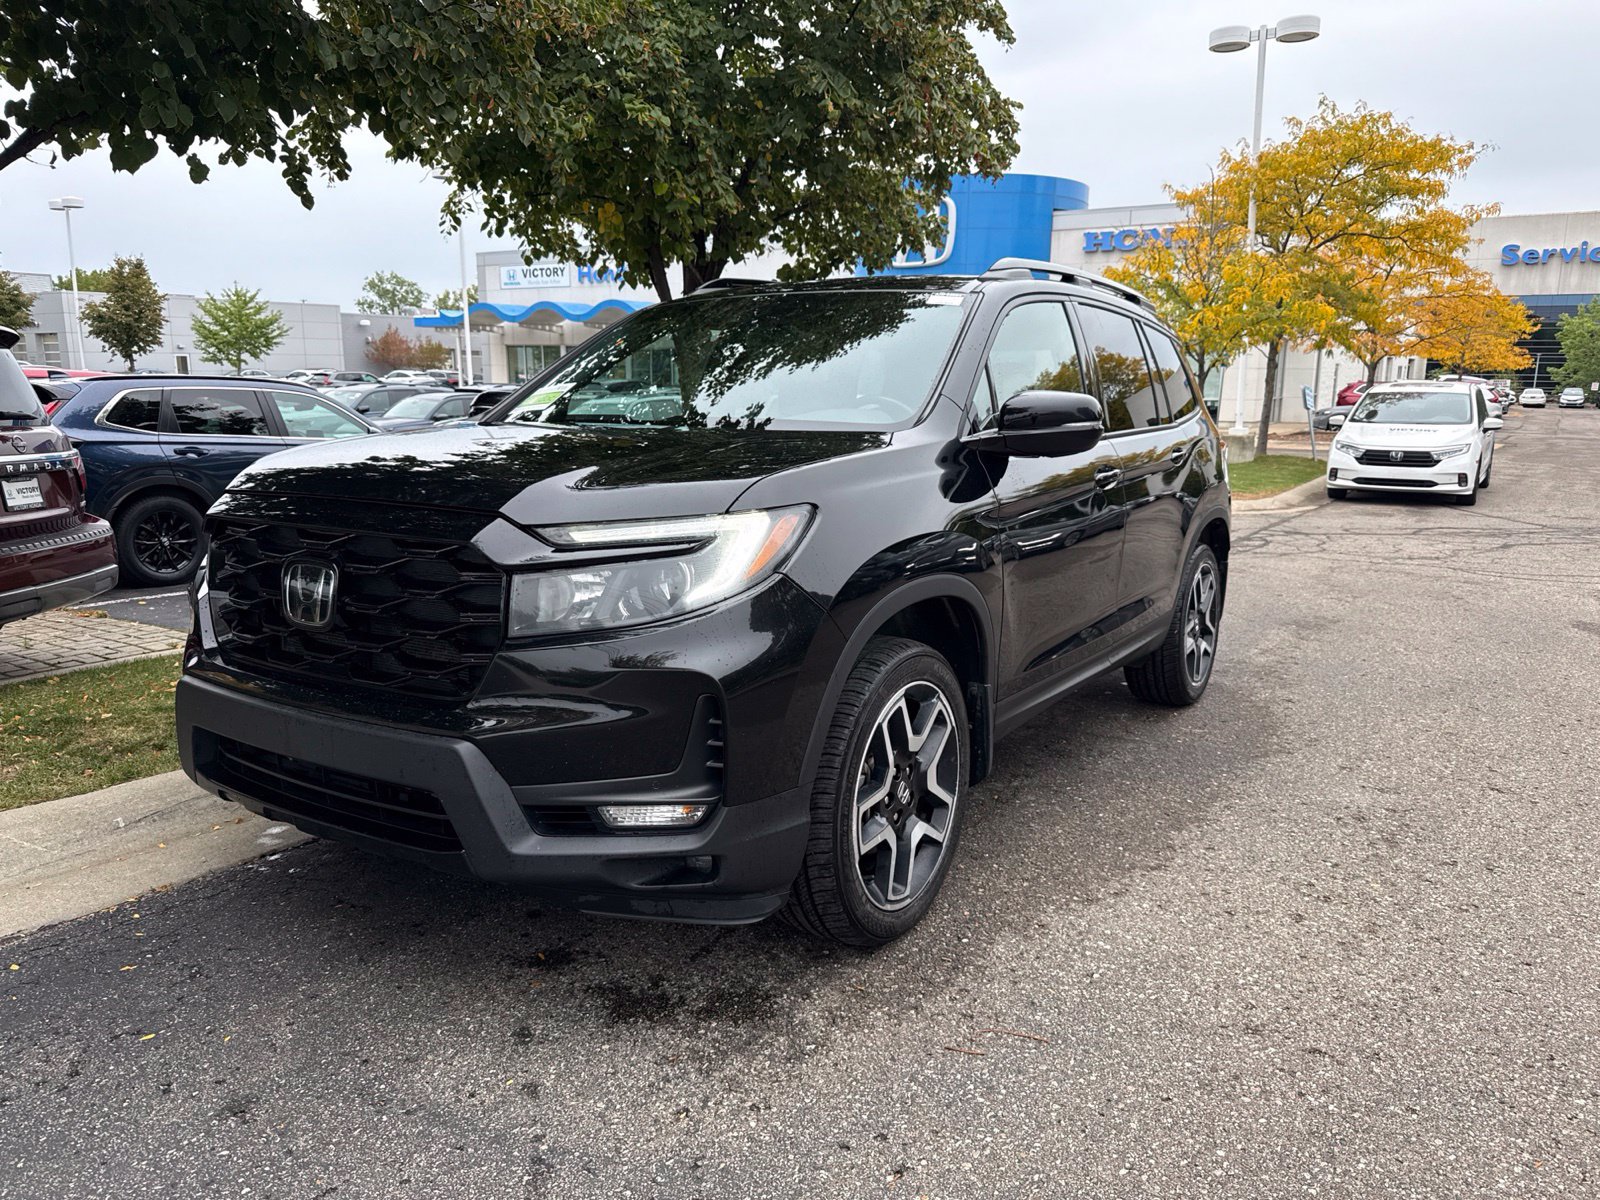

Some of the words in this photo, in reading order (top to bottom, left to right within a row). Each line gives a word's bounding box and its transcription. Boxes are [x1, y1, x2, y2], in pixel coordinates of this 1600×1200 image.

[1501, 240, 1600, 267] Servic
[521, 267, 566, 278] VICTORY
[16, 487, 39, 495] VICTORY
